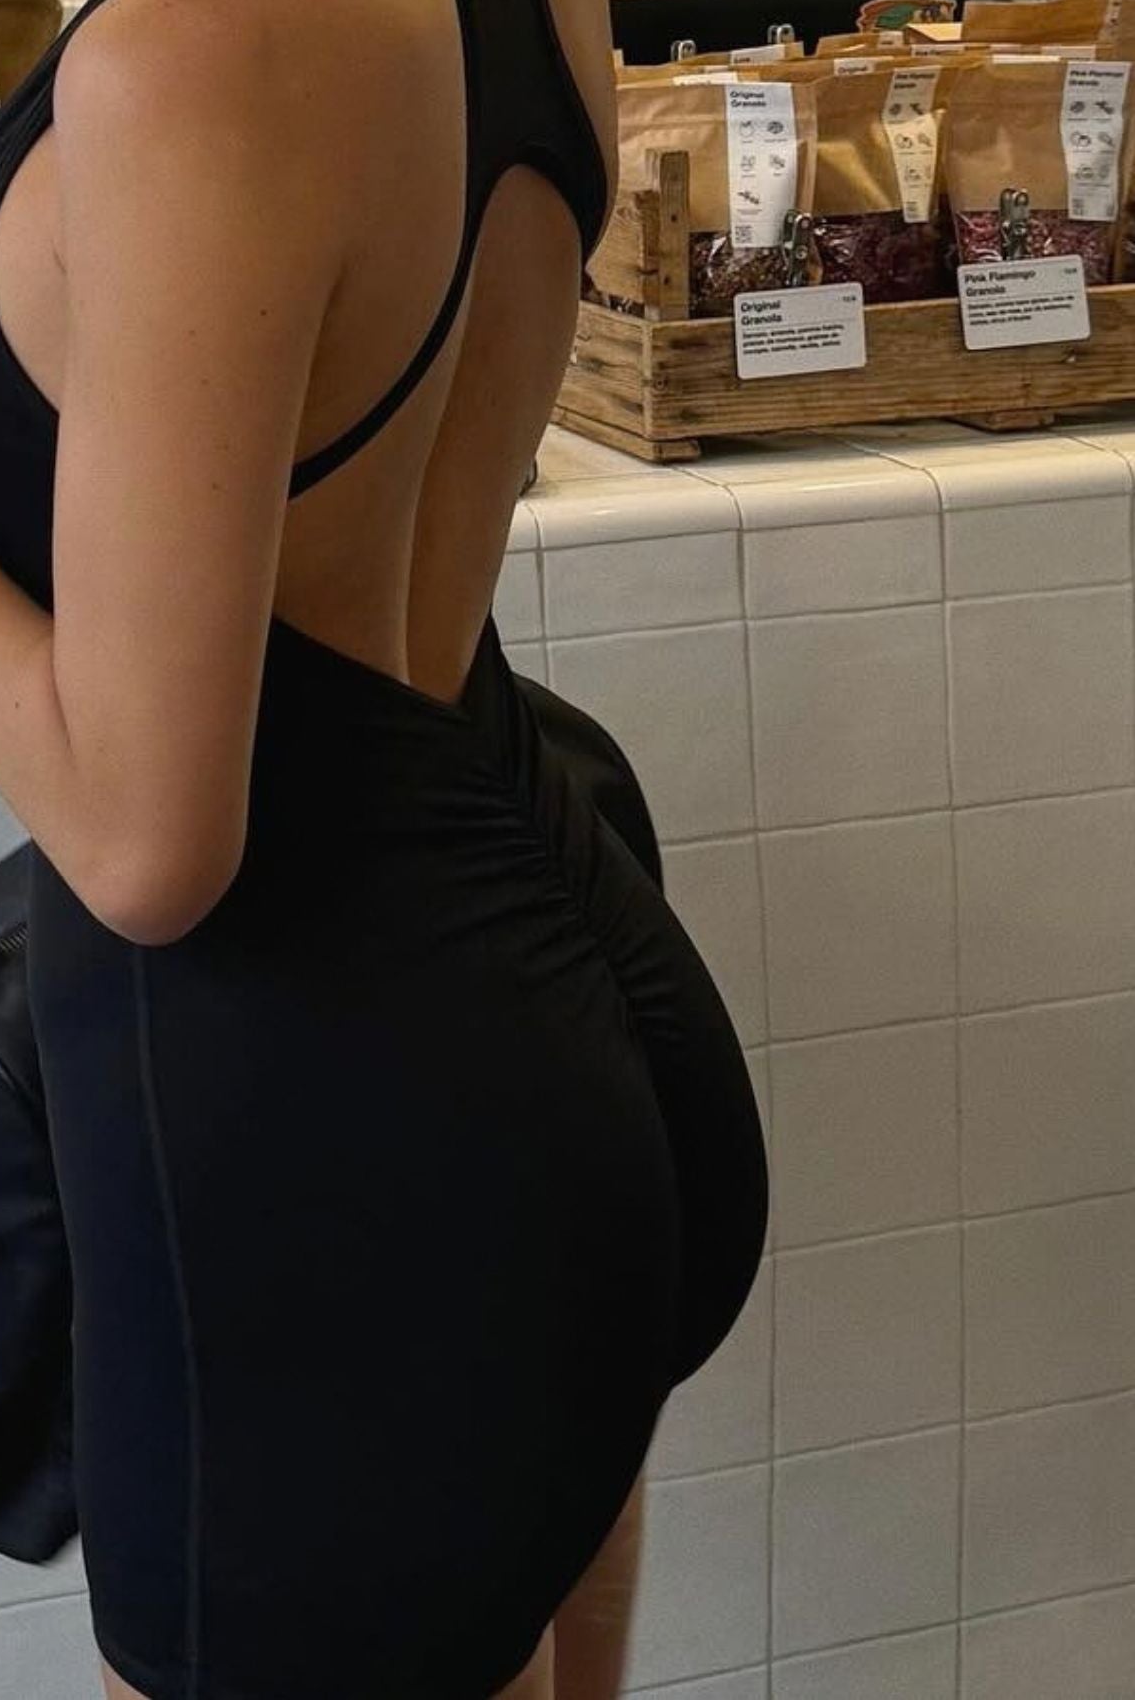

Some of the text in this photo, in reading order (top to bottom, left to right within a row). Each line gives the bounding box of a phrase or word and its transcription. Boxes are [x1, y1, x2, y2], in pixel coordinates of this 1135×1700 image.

[965, 270, 1036, 284] Pink Flamingo
[967, 286, 1005, 297] Granola
[741, 301, 781, 312] Original
[741, 313, 782, 325] Granola
